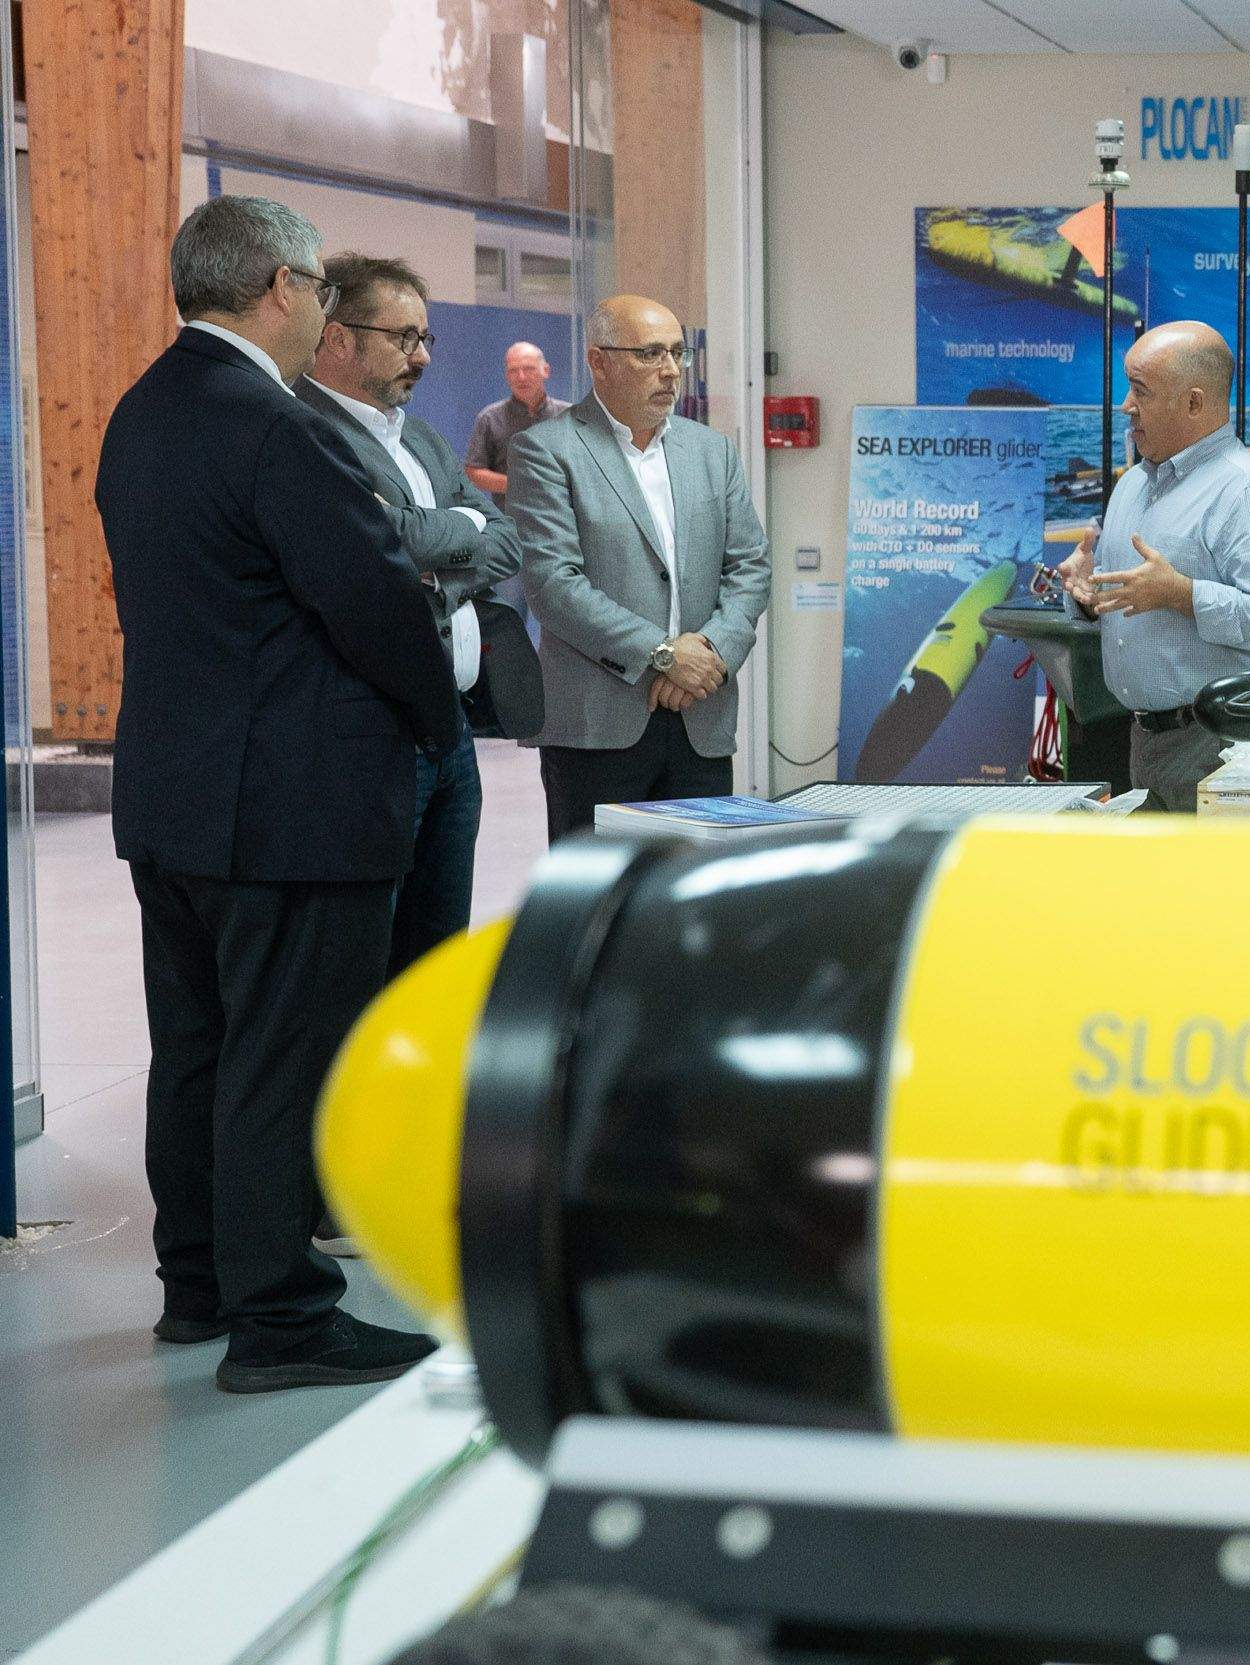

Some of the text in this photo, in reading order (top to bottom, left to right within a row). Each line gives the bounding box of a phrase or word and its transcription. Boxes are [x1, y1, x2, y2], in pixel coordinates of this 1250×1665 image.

[1141, 97, 1240, 160] PLOCAN
[945, 339, 1075, 362] marine technology
[857, 437, 1042, 462] SEA EXPLORER glider
[855, 499, 979, 520] World Record
[868, 523, 897, 537] days
[943, 525, 963, 537] km
[906, 544, 914, 552] +
[935, 543, 980, 554] sensors
[851, 558, 956, 573] on a single battery
[851, 576, 891, 588] charge
